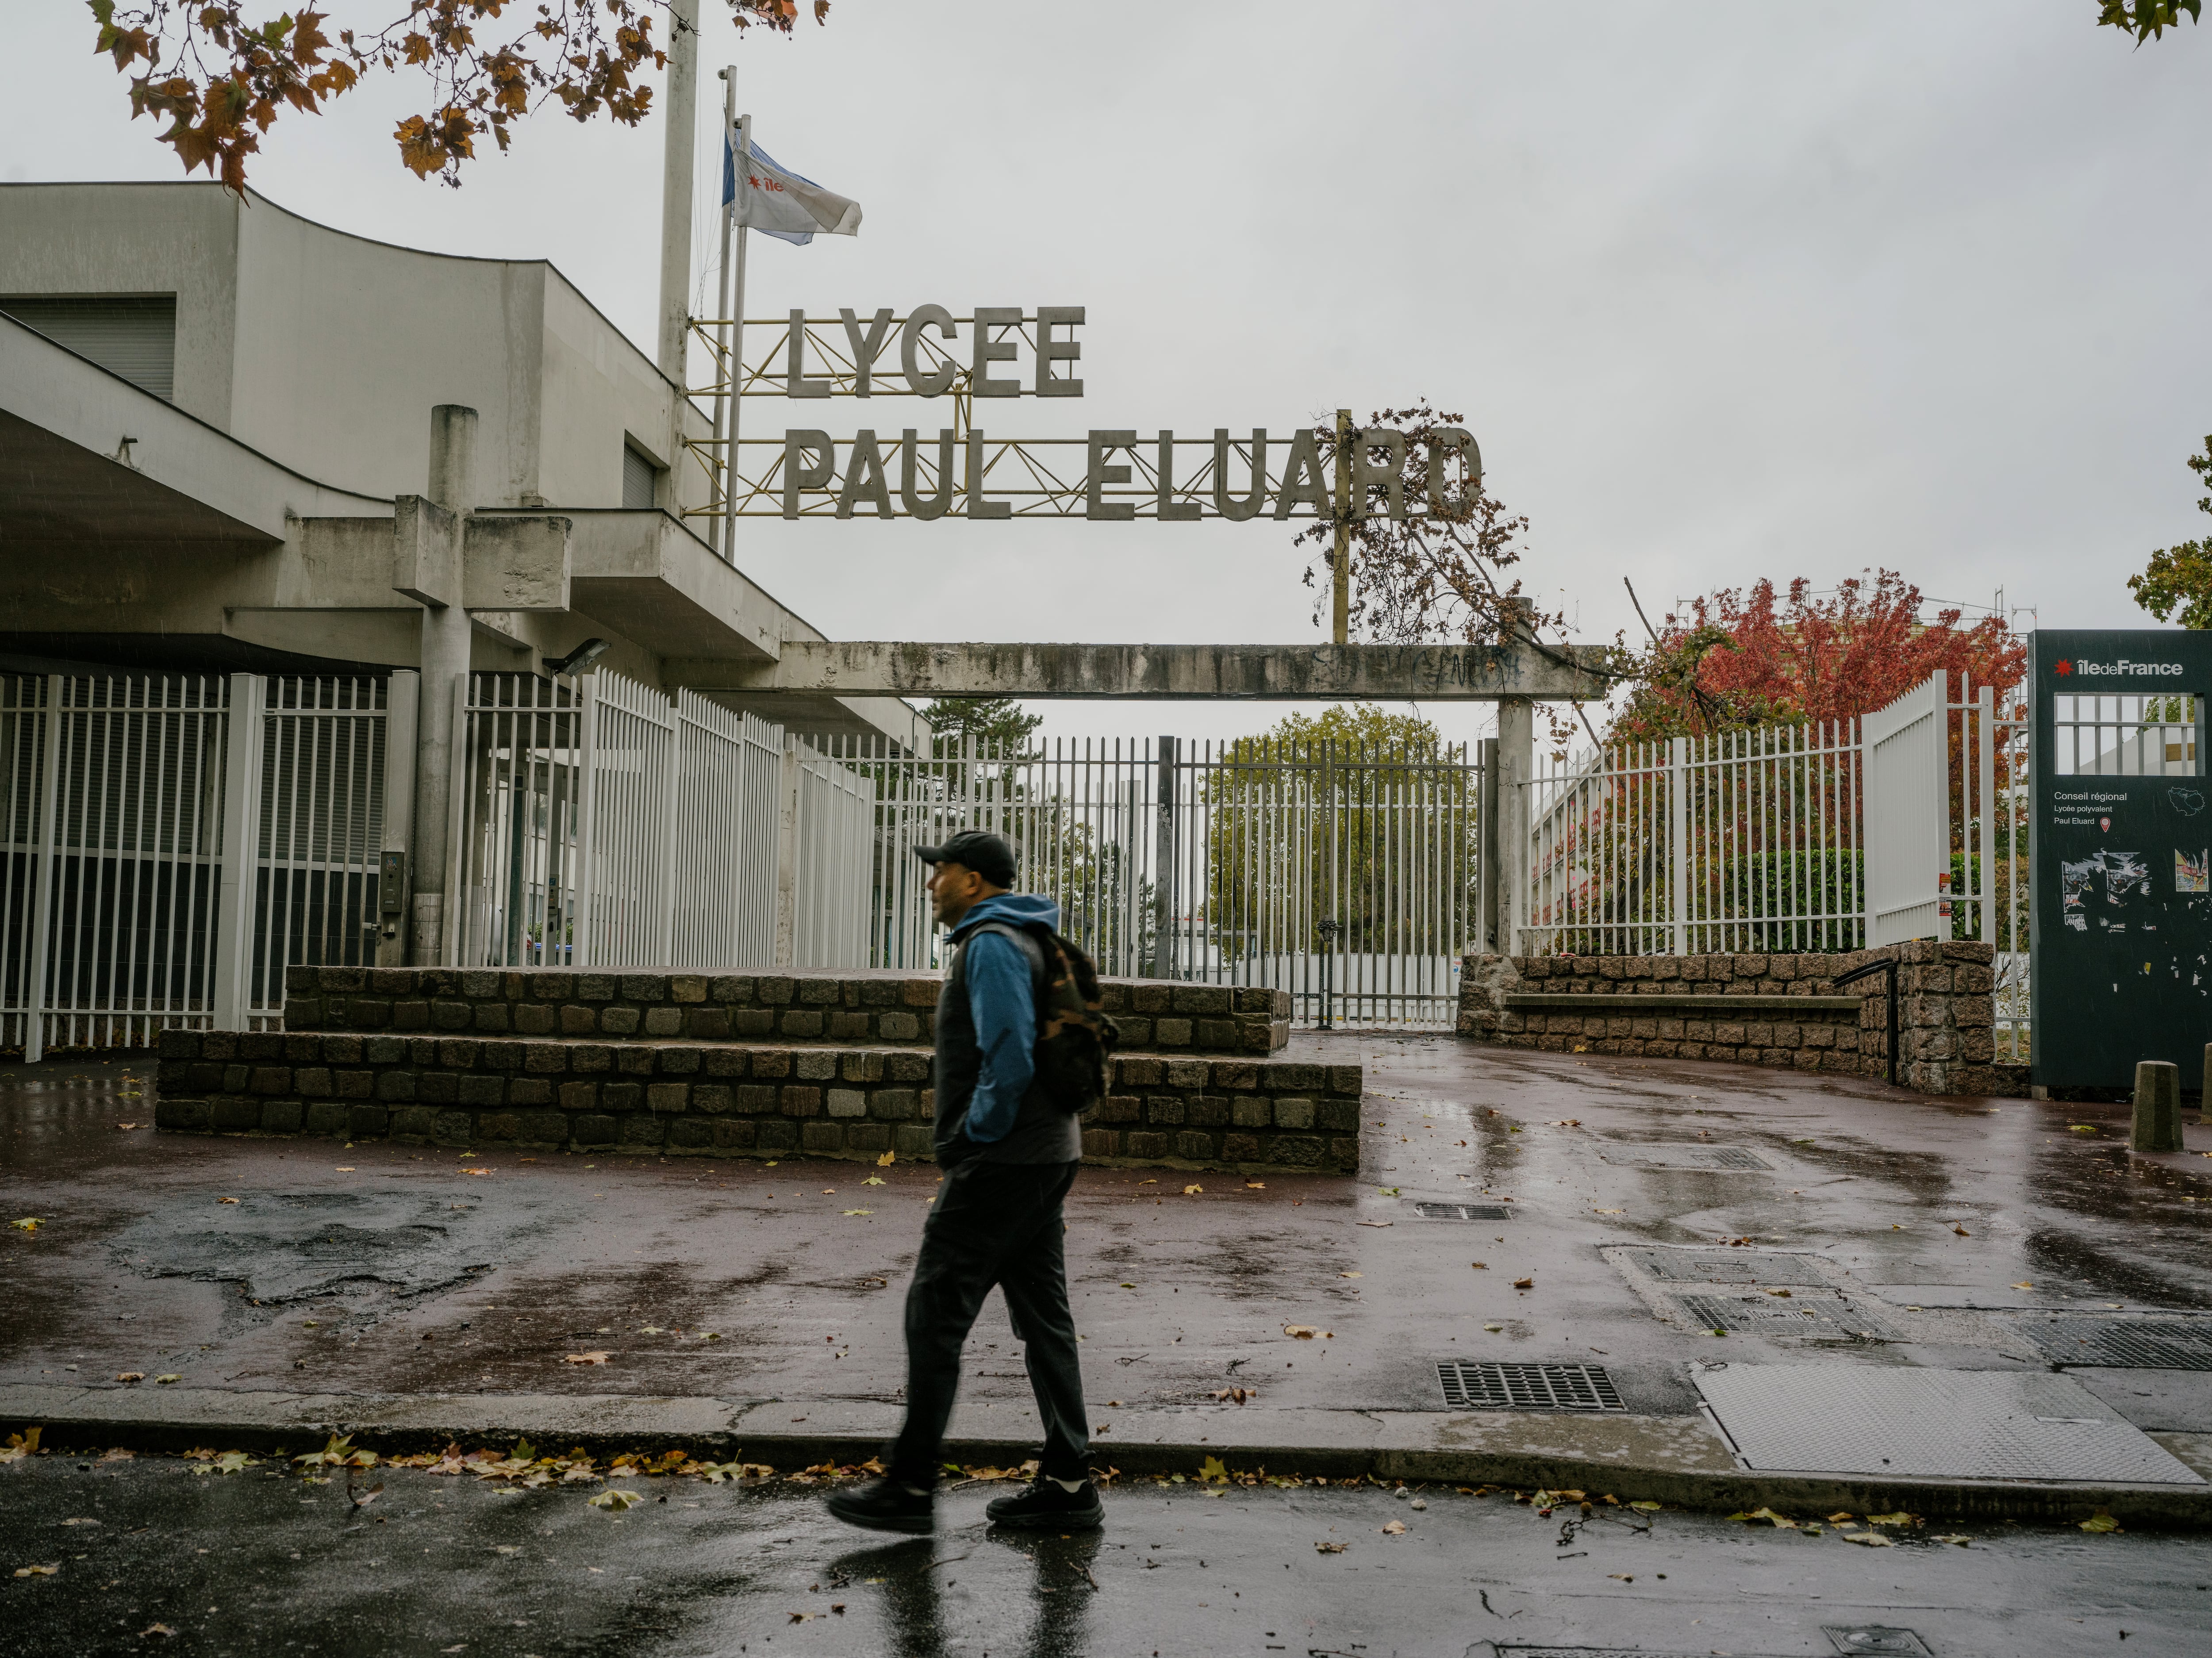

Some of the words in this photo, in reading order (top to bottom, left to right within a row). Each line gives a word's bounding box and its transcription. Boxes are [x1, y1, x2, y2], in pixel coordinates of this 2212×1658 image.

[764, 177, 784, 192] île
[787, 303, 1086, 398] LYCEE
[783, 429, 1012, 521] PAUL
[1087, 428, 1482, 522] ELUARD
[2091, 792, 2127, 802] régional
